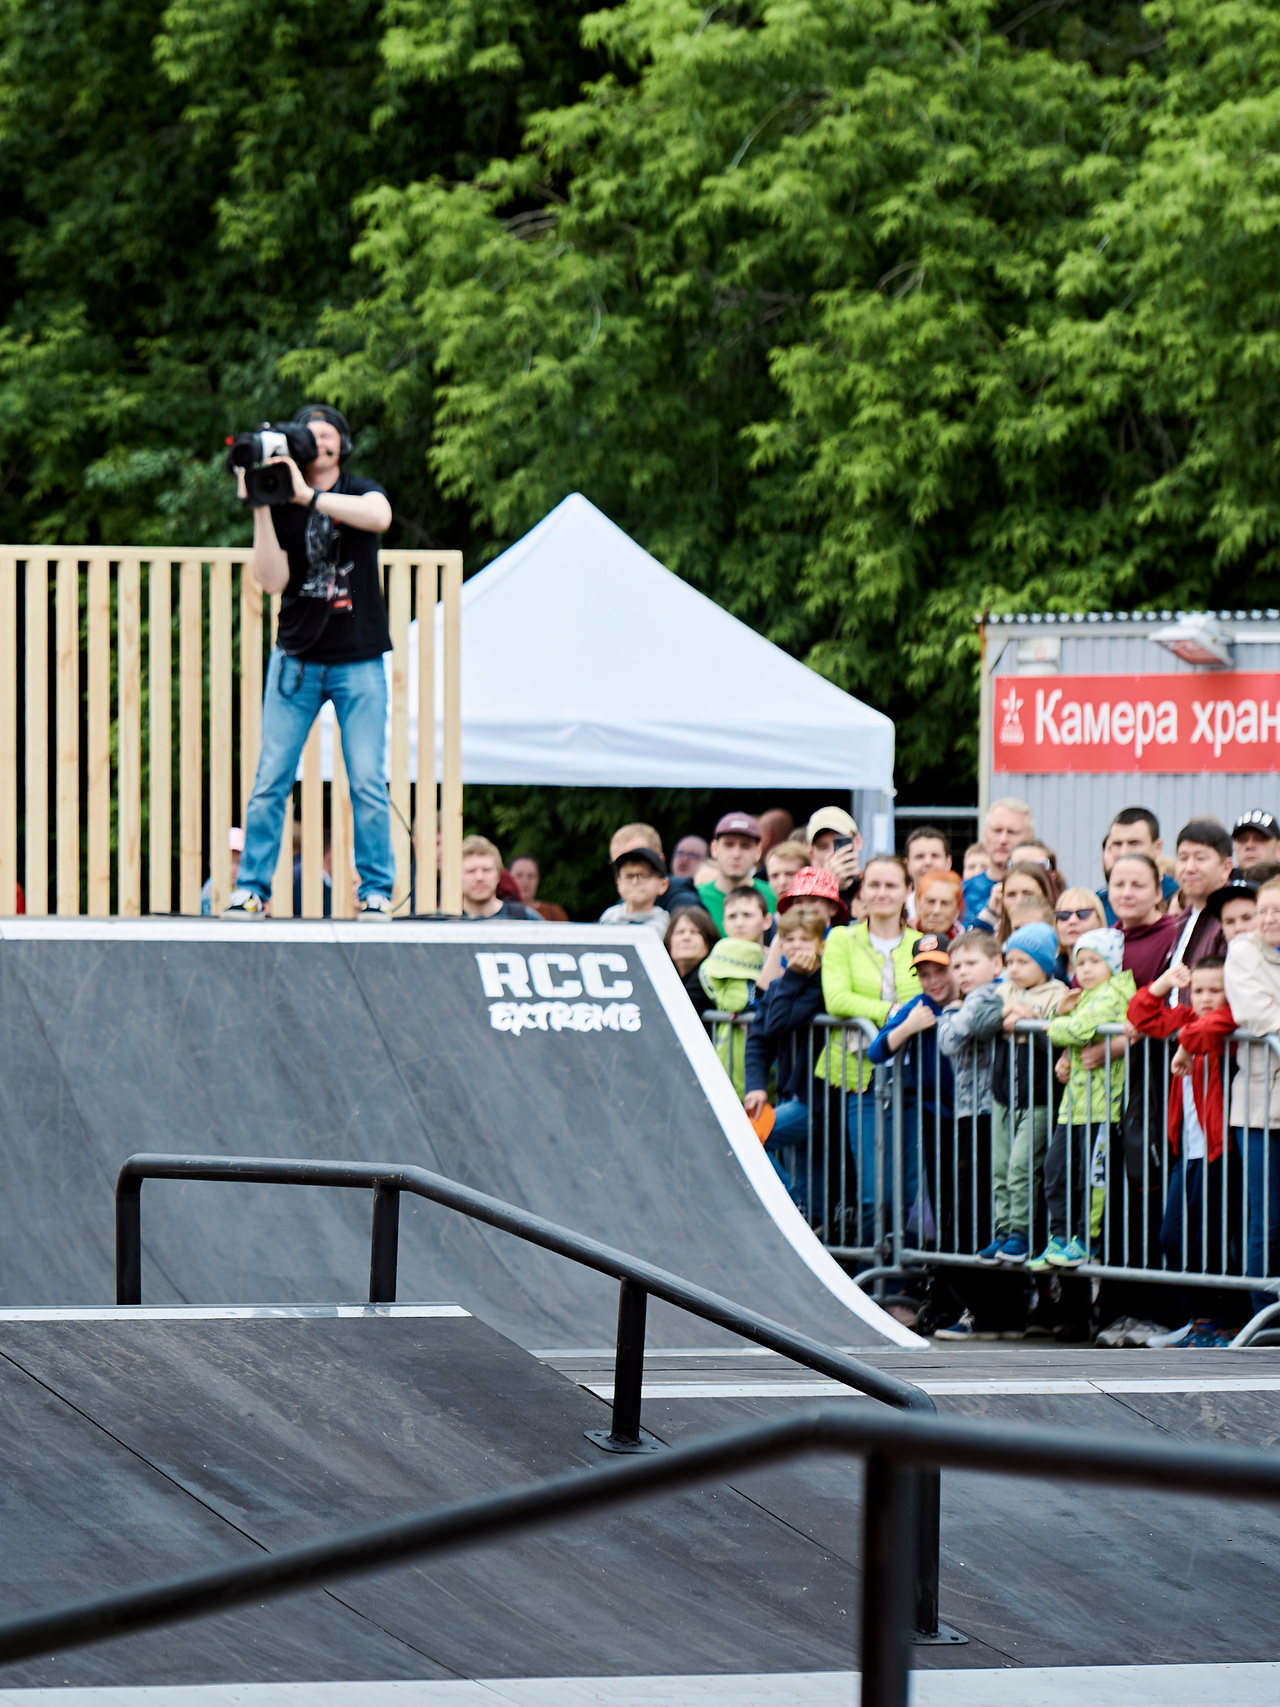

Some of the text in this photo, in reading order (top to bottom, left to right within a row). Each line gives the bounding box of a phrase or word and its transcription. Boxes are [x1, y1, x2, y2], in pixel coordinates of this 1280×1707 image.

[1035, 688, 1178, 758] Камера
[475, 952, 633, 998] RCC
[488, 1001, 642, 1036] EXTREME
